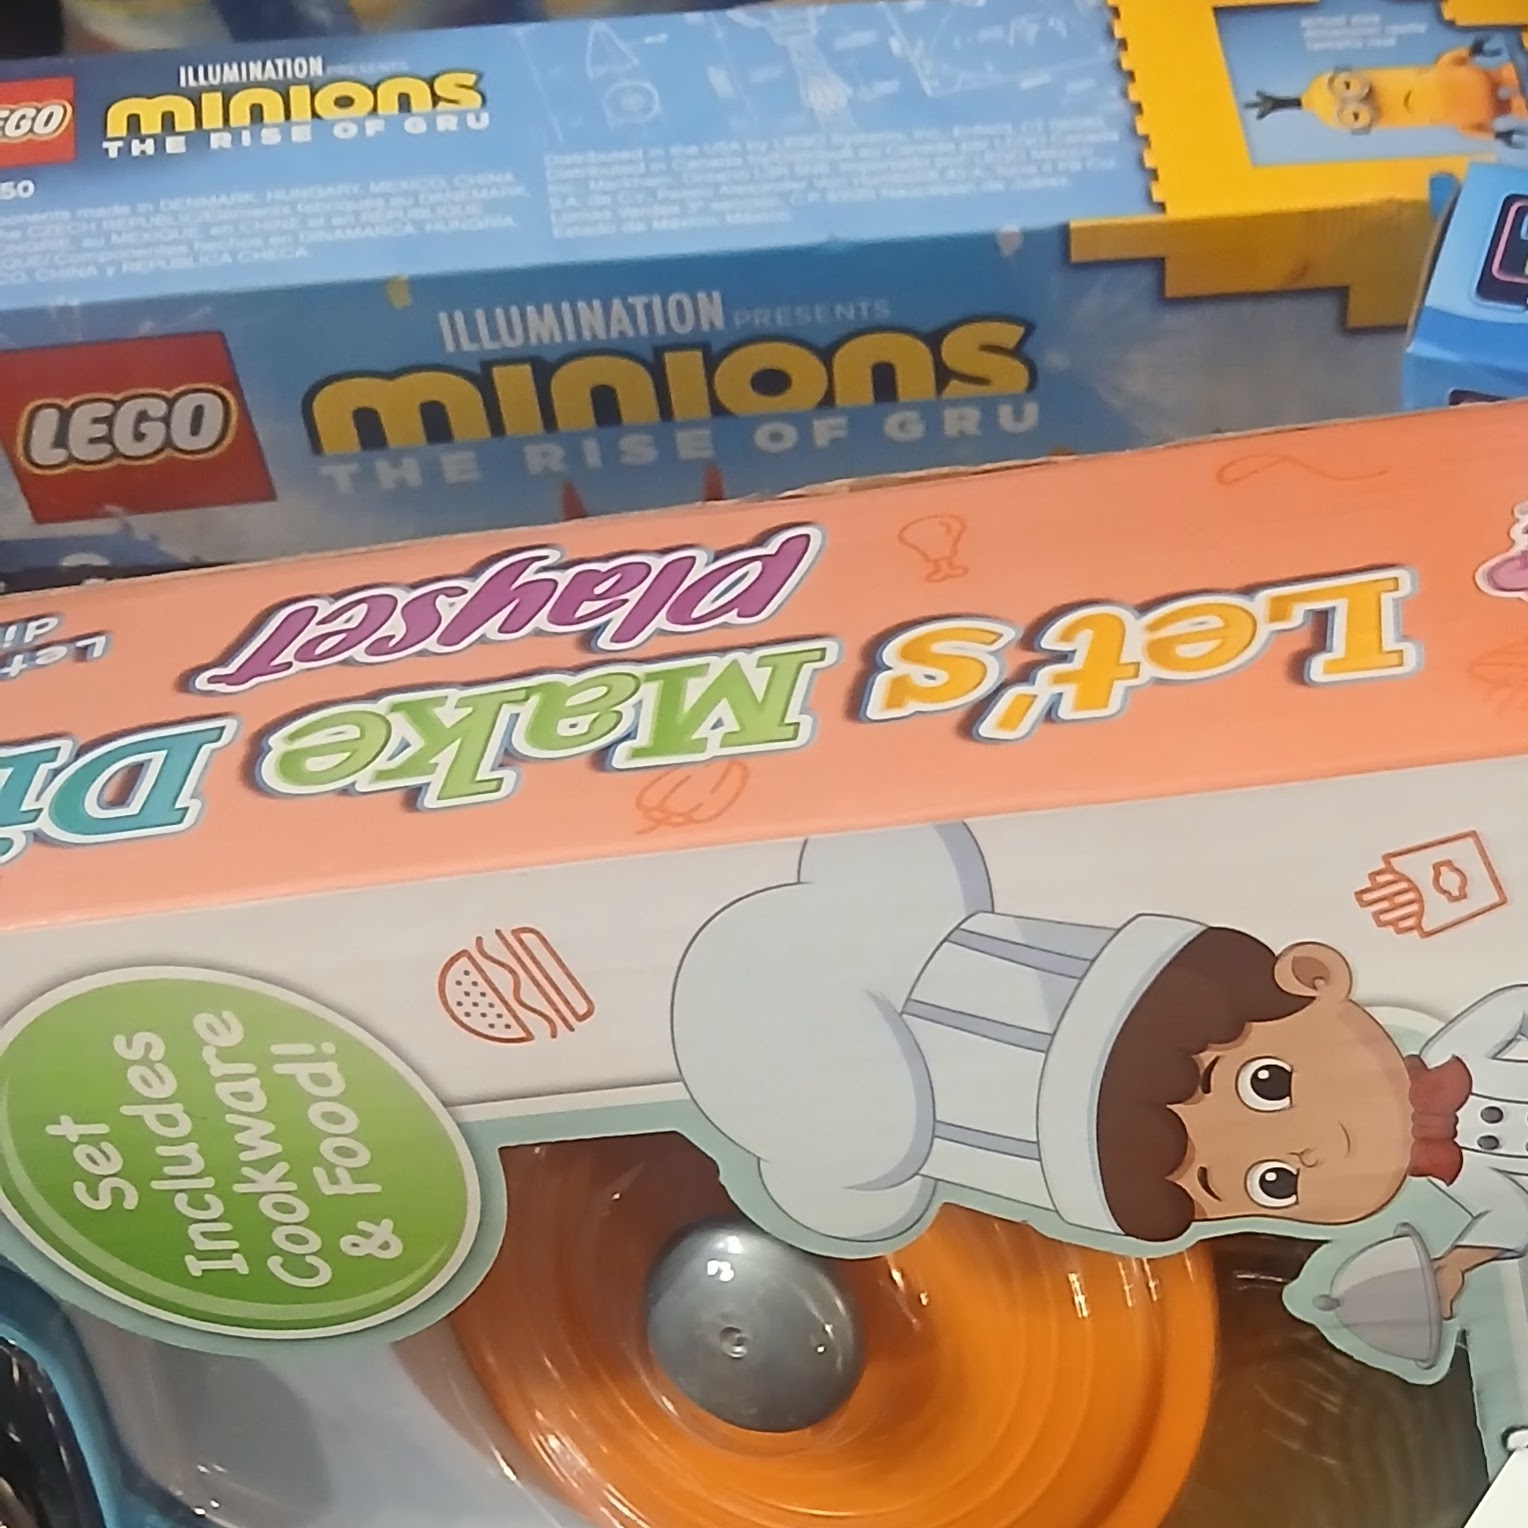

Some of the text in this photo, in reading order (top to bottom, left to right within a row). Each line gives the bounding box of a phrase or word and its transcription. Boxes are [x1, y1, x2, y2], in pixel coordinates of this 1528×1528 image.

[103, 110, 490, 158] THE RISE OF GRU
[180, 55, 324, 88] ILLUMINATION
[438, 290, 892, 353] ILLUMINATION PRESENTS
[28, 391, 228, 468] LEGO
[320, 401, 1042, 495] THE RISE OF GRU
[203, 529, 816, 691] playset
[878, 572, 1408, 733] Let's
[268, 643, 832, 805] Make
[45, 1115, 140, 1211] Set
[112, 1031, 250, 1277] Includes
[192, 1009, 333, 1289] Cookware
[269, 1041, 403, 1260] & Food!
